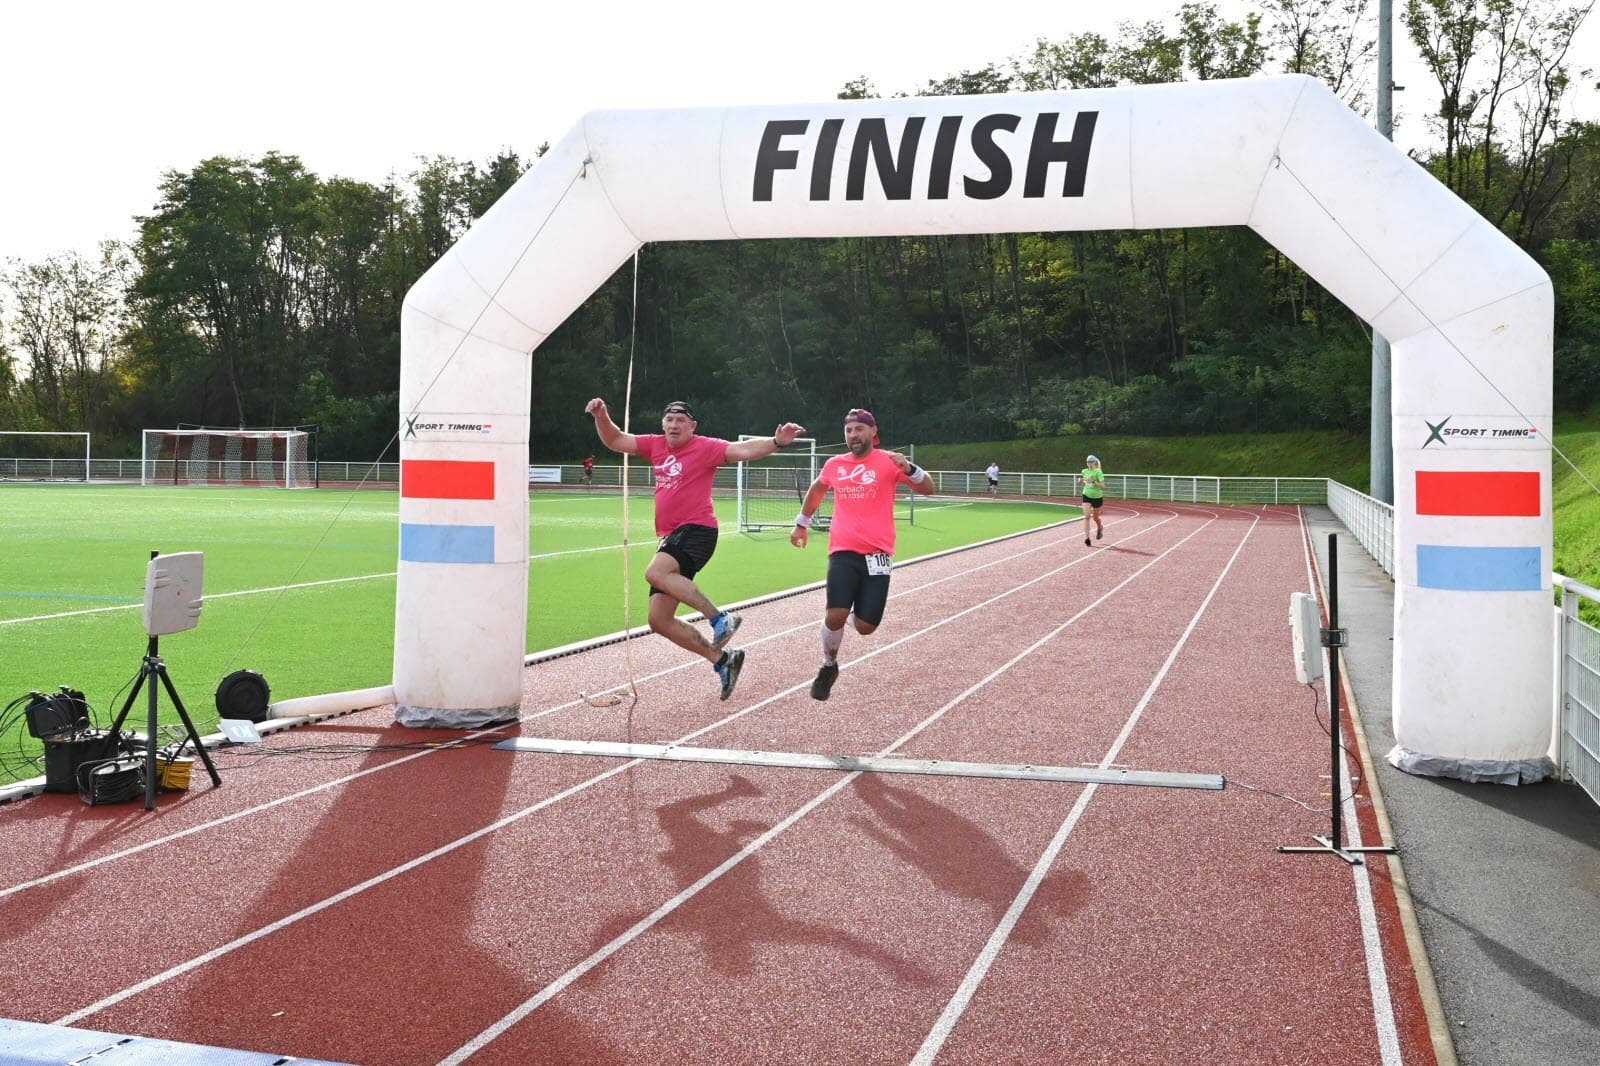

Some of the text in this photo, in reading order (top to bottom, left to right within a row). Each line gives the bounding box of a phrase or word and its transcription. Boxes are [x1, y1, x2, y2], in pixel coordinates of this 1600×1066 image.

[752, 110, 1100, 202] FINISH
[447, 423, 483, 432] TIMING
[1492, 428, 1529, 437] TIMING
